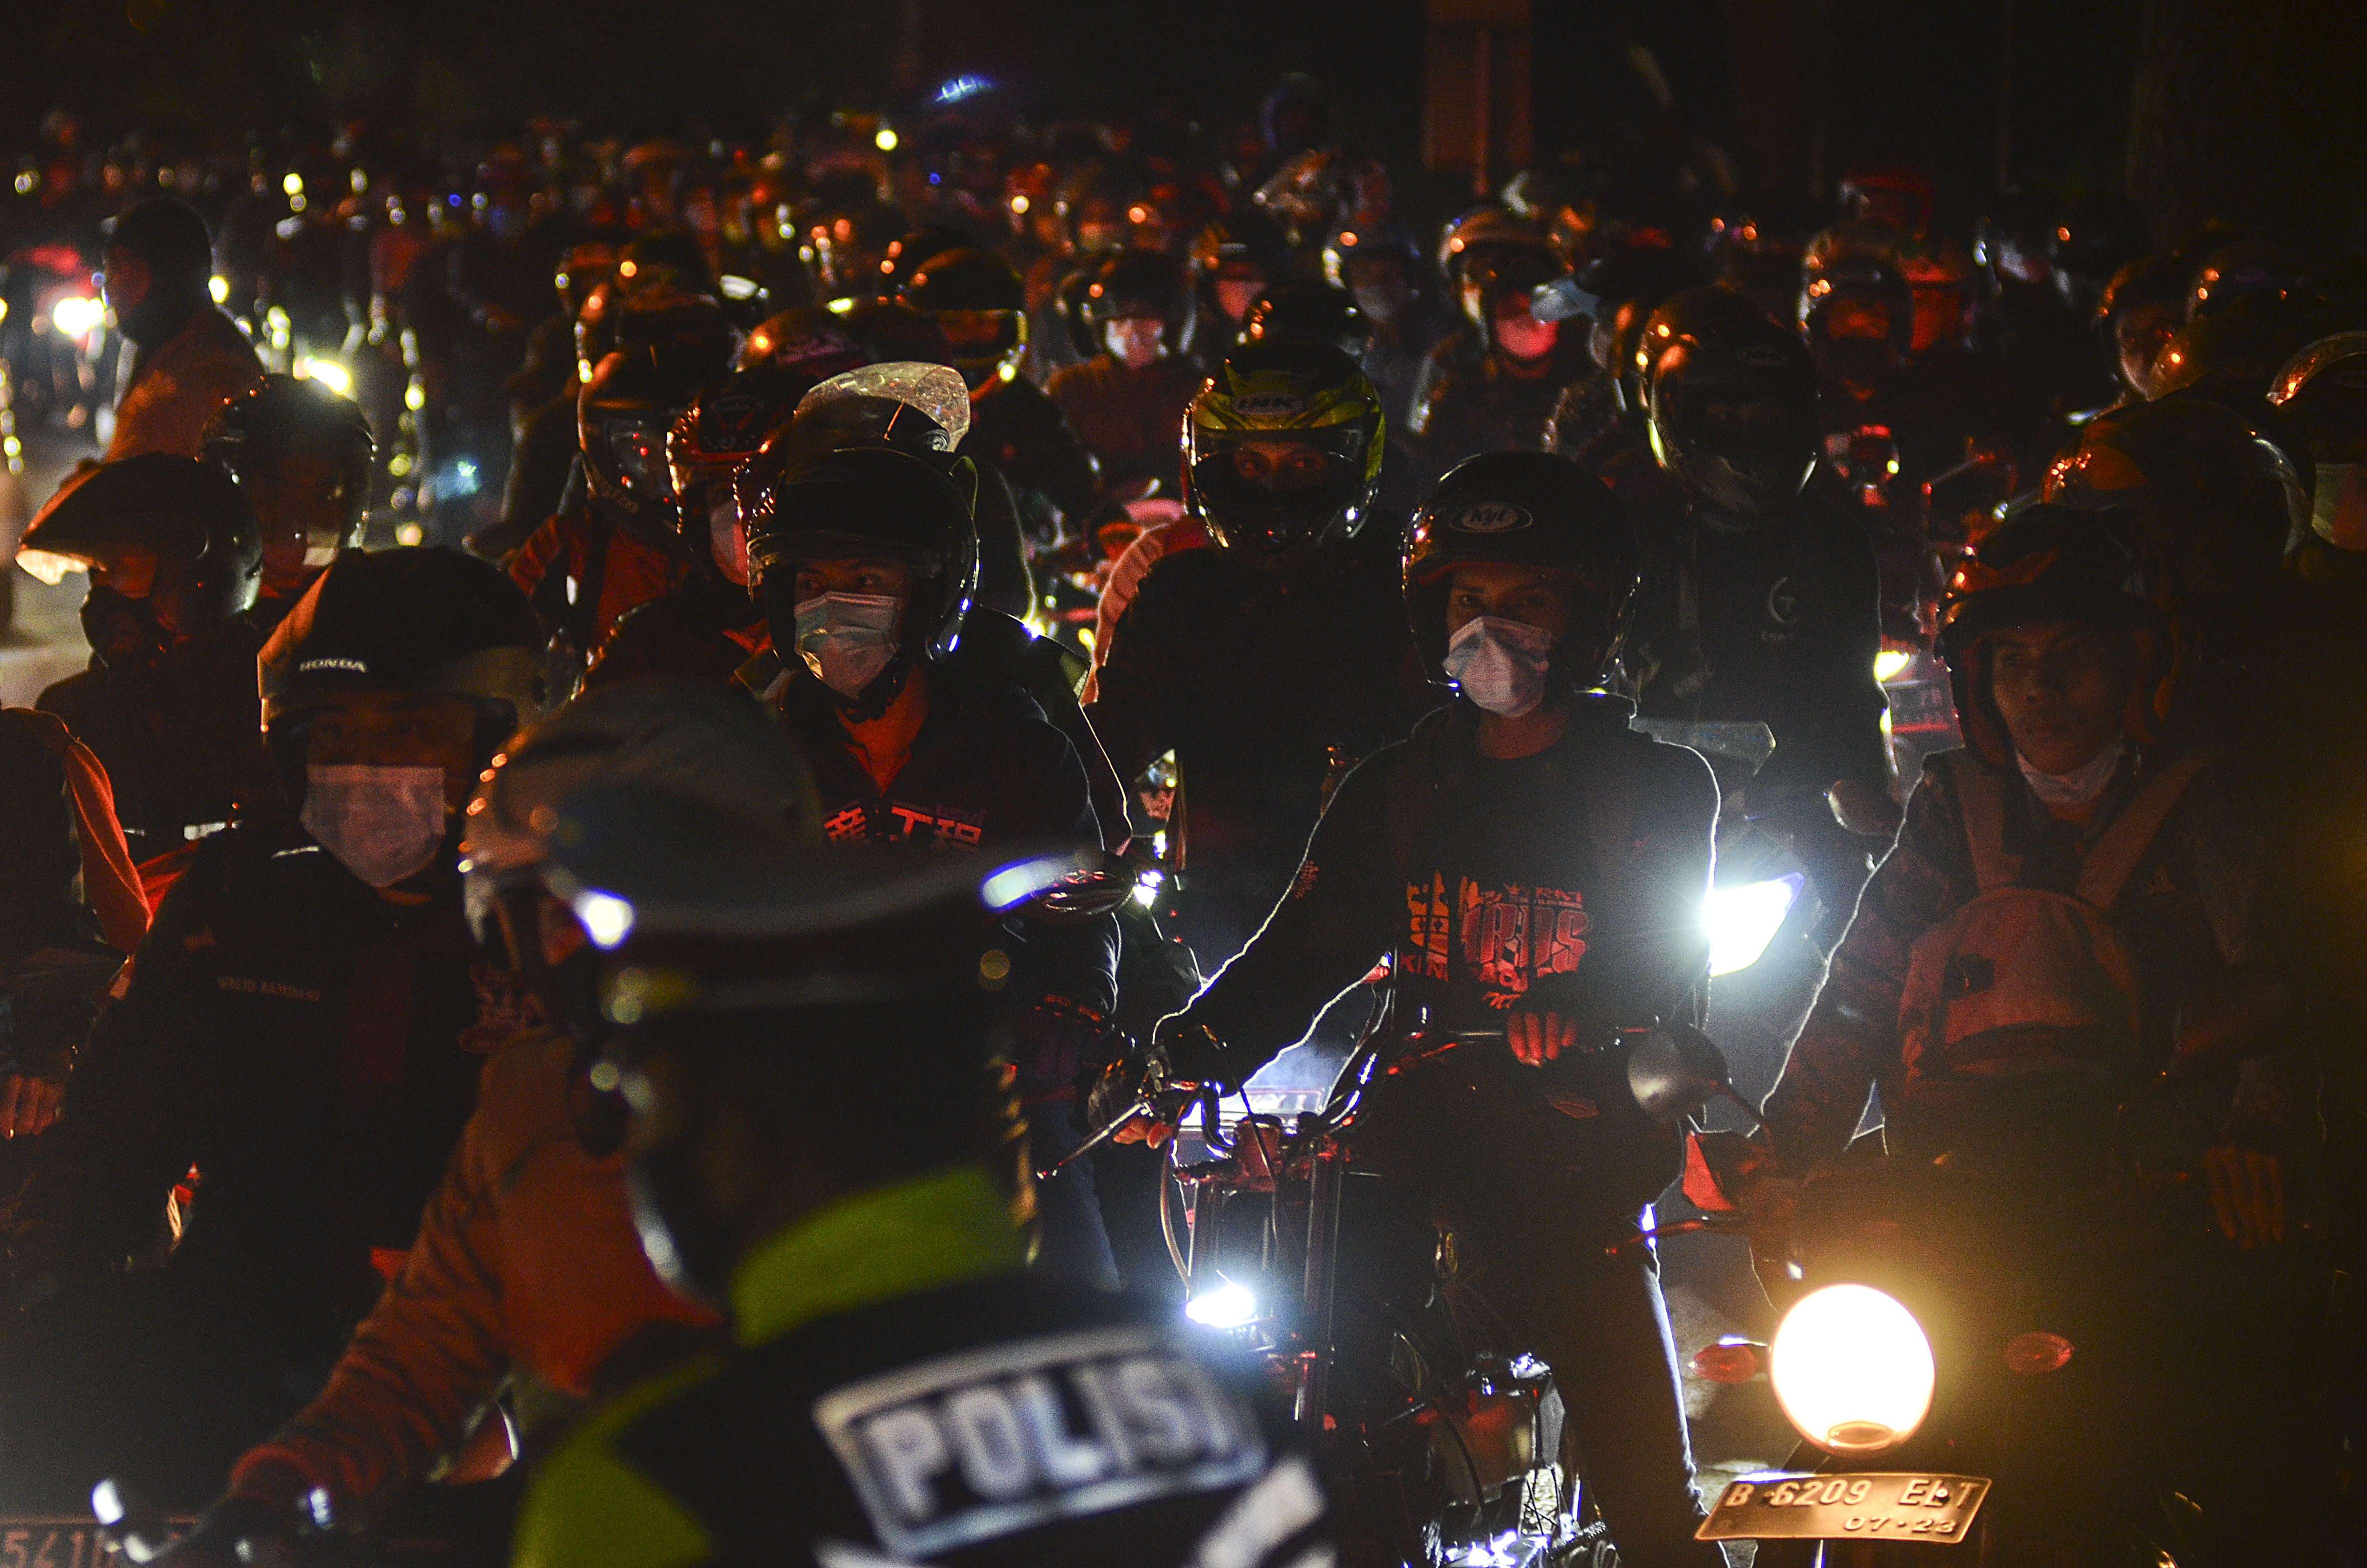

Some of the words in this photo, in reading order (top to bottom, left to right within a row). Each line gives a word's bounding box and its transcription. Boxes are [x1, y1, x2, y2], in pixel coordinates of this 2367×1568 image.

[299, 658, 368, 673] HONDA
[863, 1355, 1244, 1520] POLISI
[1724, 1483, 1754, 1507] B
[1769, 1479, 1872, 1507] 6209
[1898, 1479, 1981, 1508] ELT
